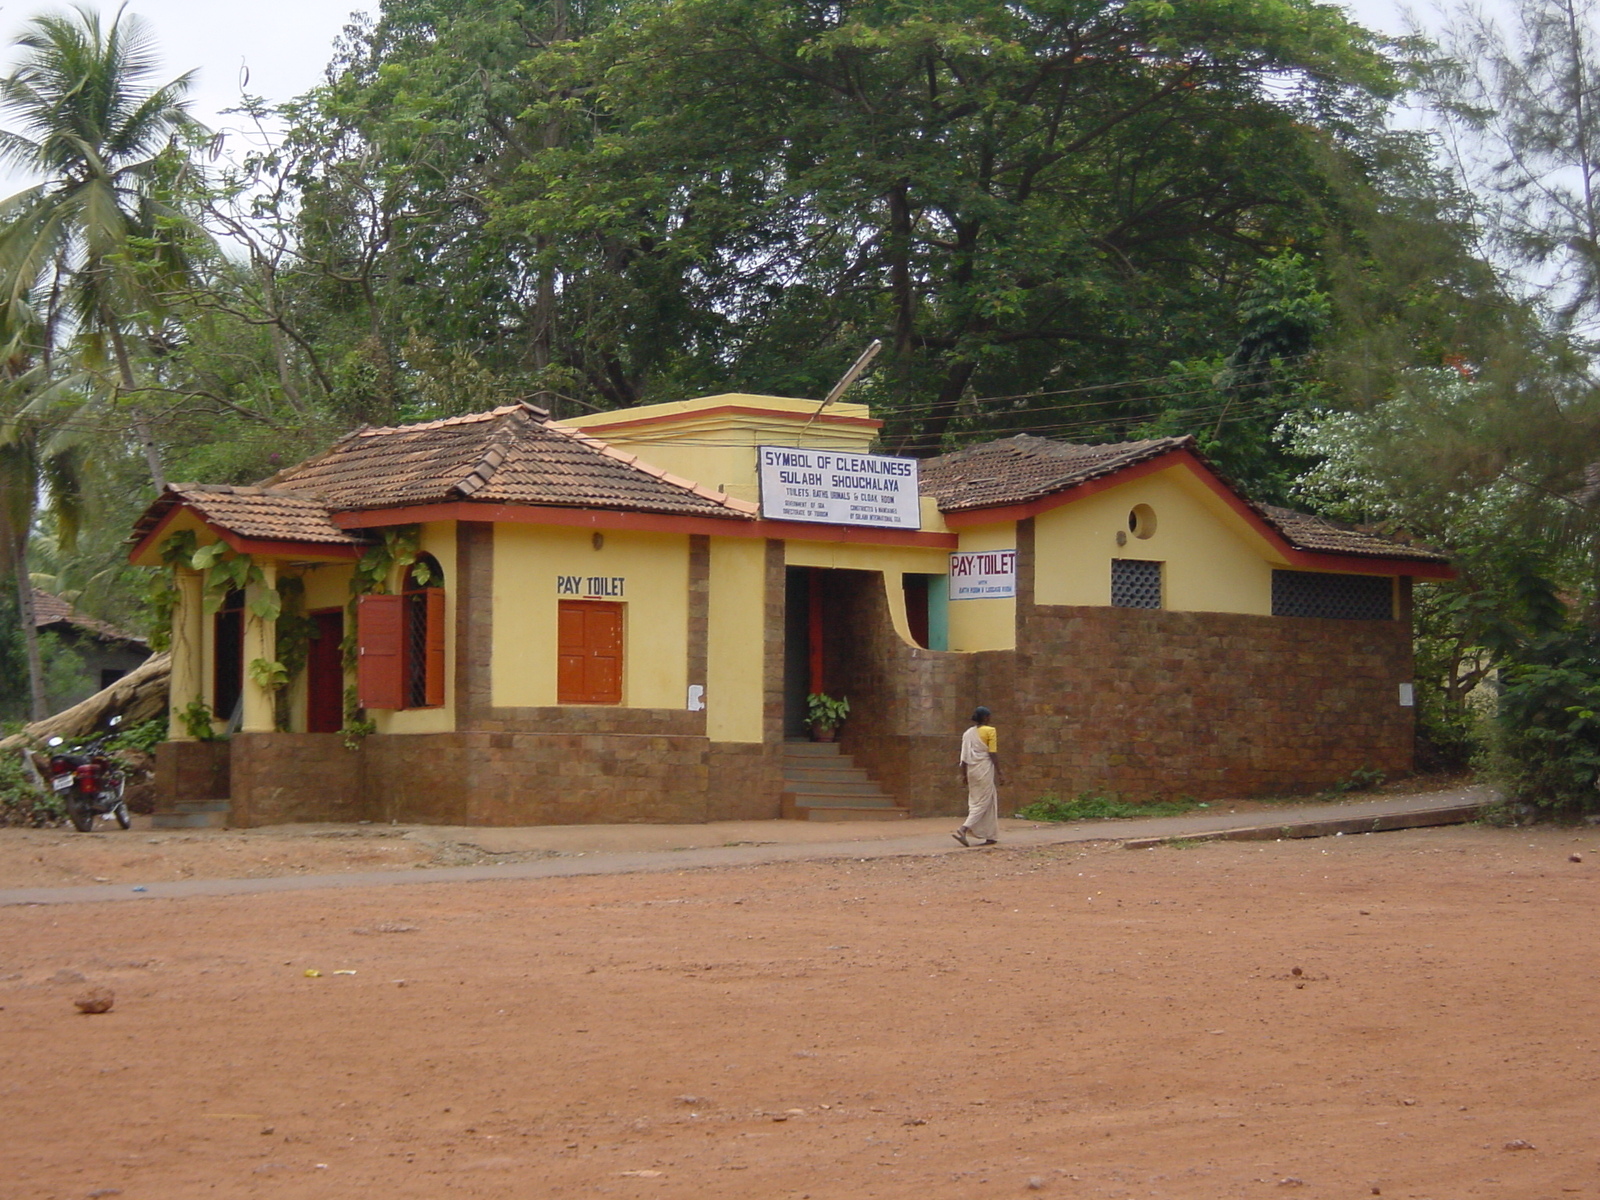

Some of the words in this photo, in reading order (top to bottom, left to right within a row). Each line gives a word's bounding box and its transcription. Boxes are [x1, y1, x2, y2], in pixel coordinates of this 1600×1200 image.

[766, 451, 812, 468] SYMBOL
[817, 456, 831, 469] OF
[836, 457, 911, 477] CLEANLINESS
[780, 471, 822, 486] SULABH
[831, 474, 899, 492] SHOUCHALAYA
[861, 493, 877, 503] CLOAK
[557, 575, 582, 594] PAY
[587, 576, 625, 596] TOILET
